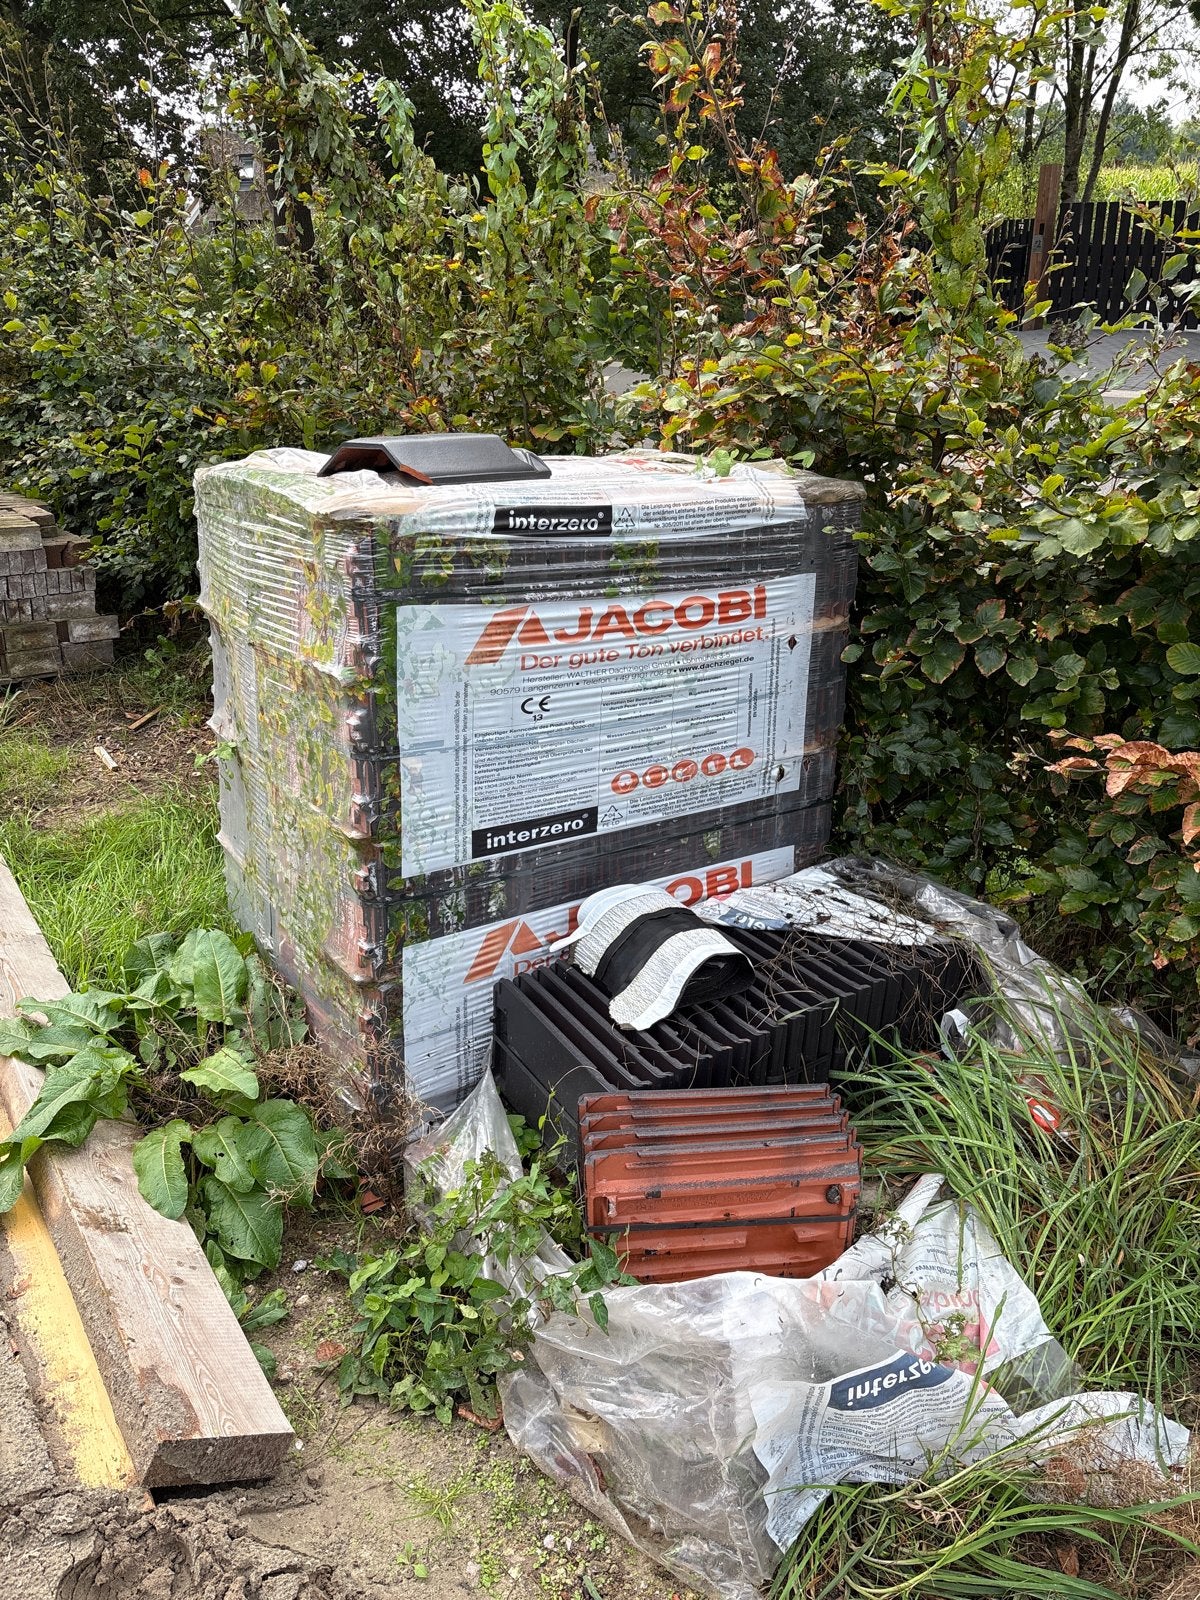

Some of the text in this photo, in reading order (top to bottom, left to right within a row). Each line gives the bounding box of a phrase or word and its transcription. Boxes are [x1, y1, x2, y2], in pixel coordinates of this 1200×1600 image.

[650, 502, 671, 510] Leistung
[652, 508, 674, 516] erklärten
[714, 502, 738, 511] Erstellung
[554, 586, 768, 644] JACOBI
[520, 626, 770, 671] Der gute Ton verbindet.
[490, 688, 521, 696] 90579
[522, 682, 574, 693] Langenzenn
[583, 676, 612, 686] Telefon:
[614, 674, 630, 682] +49
[678, 655, 755, 673] www.dachziegel.de
[566, 668, 608, 679] WALTHER
[532, 714, 544, 722] 13
[544, 860, 752, 943] JOBI
[874, 1472, 887, 1480] und
